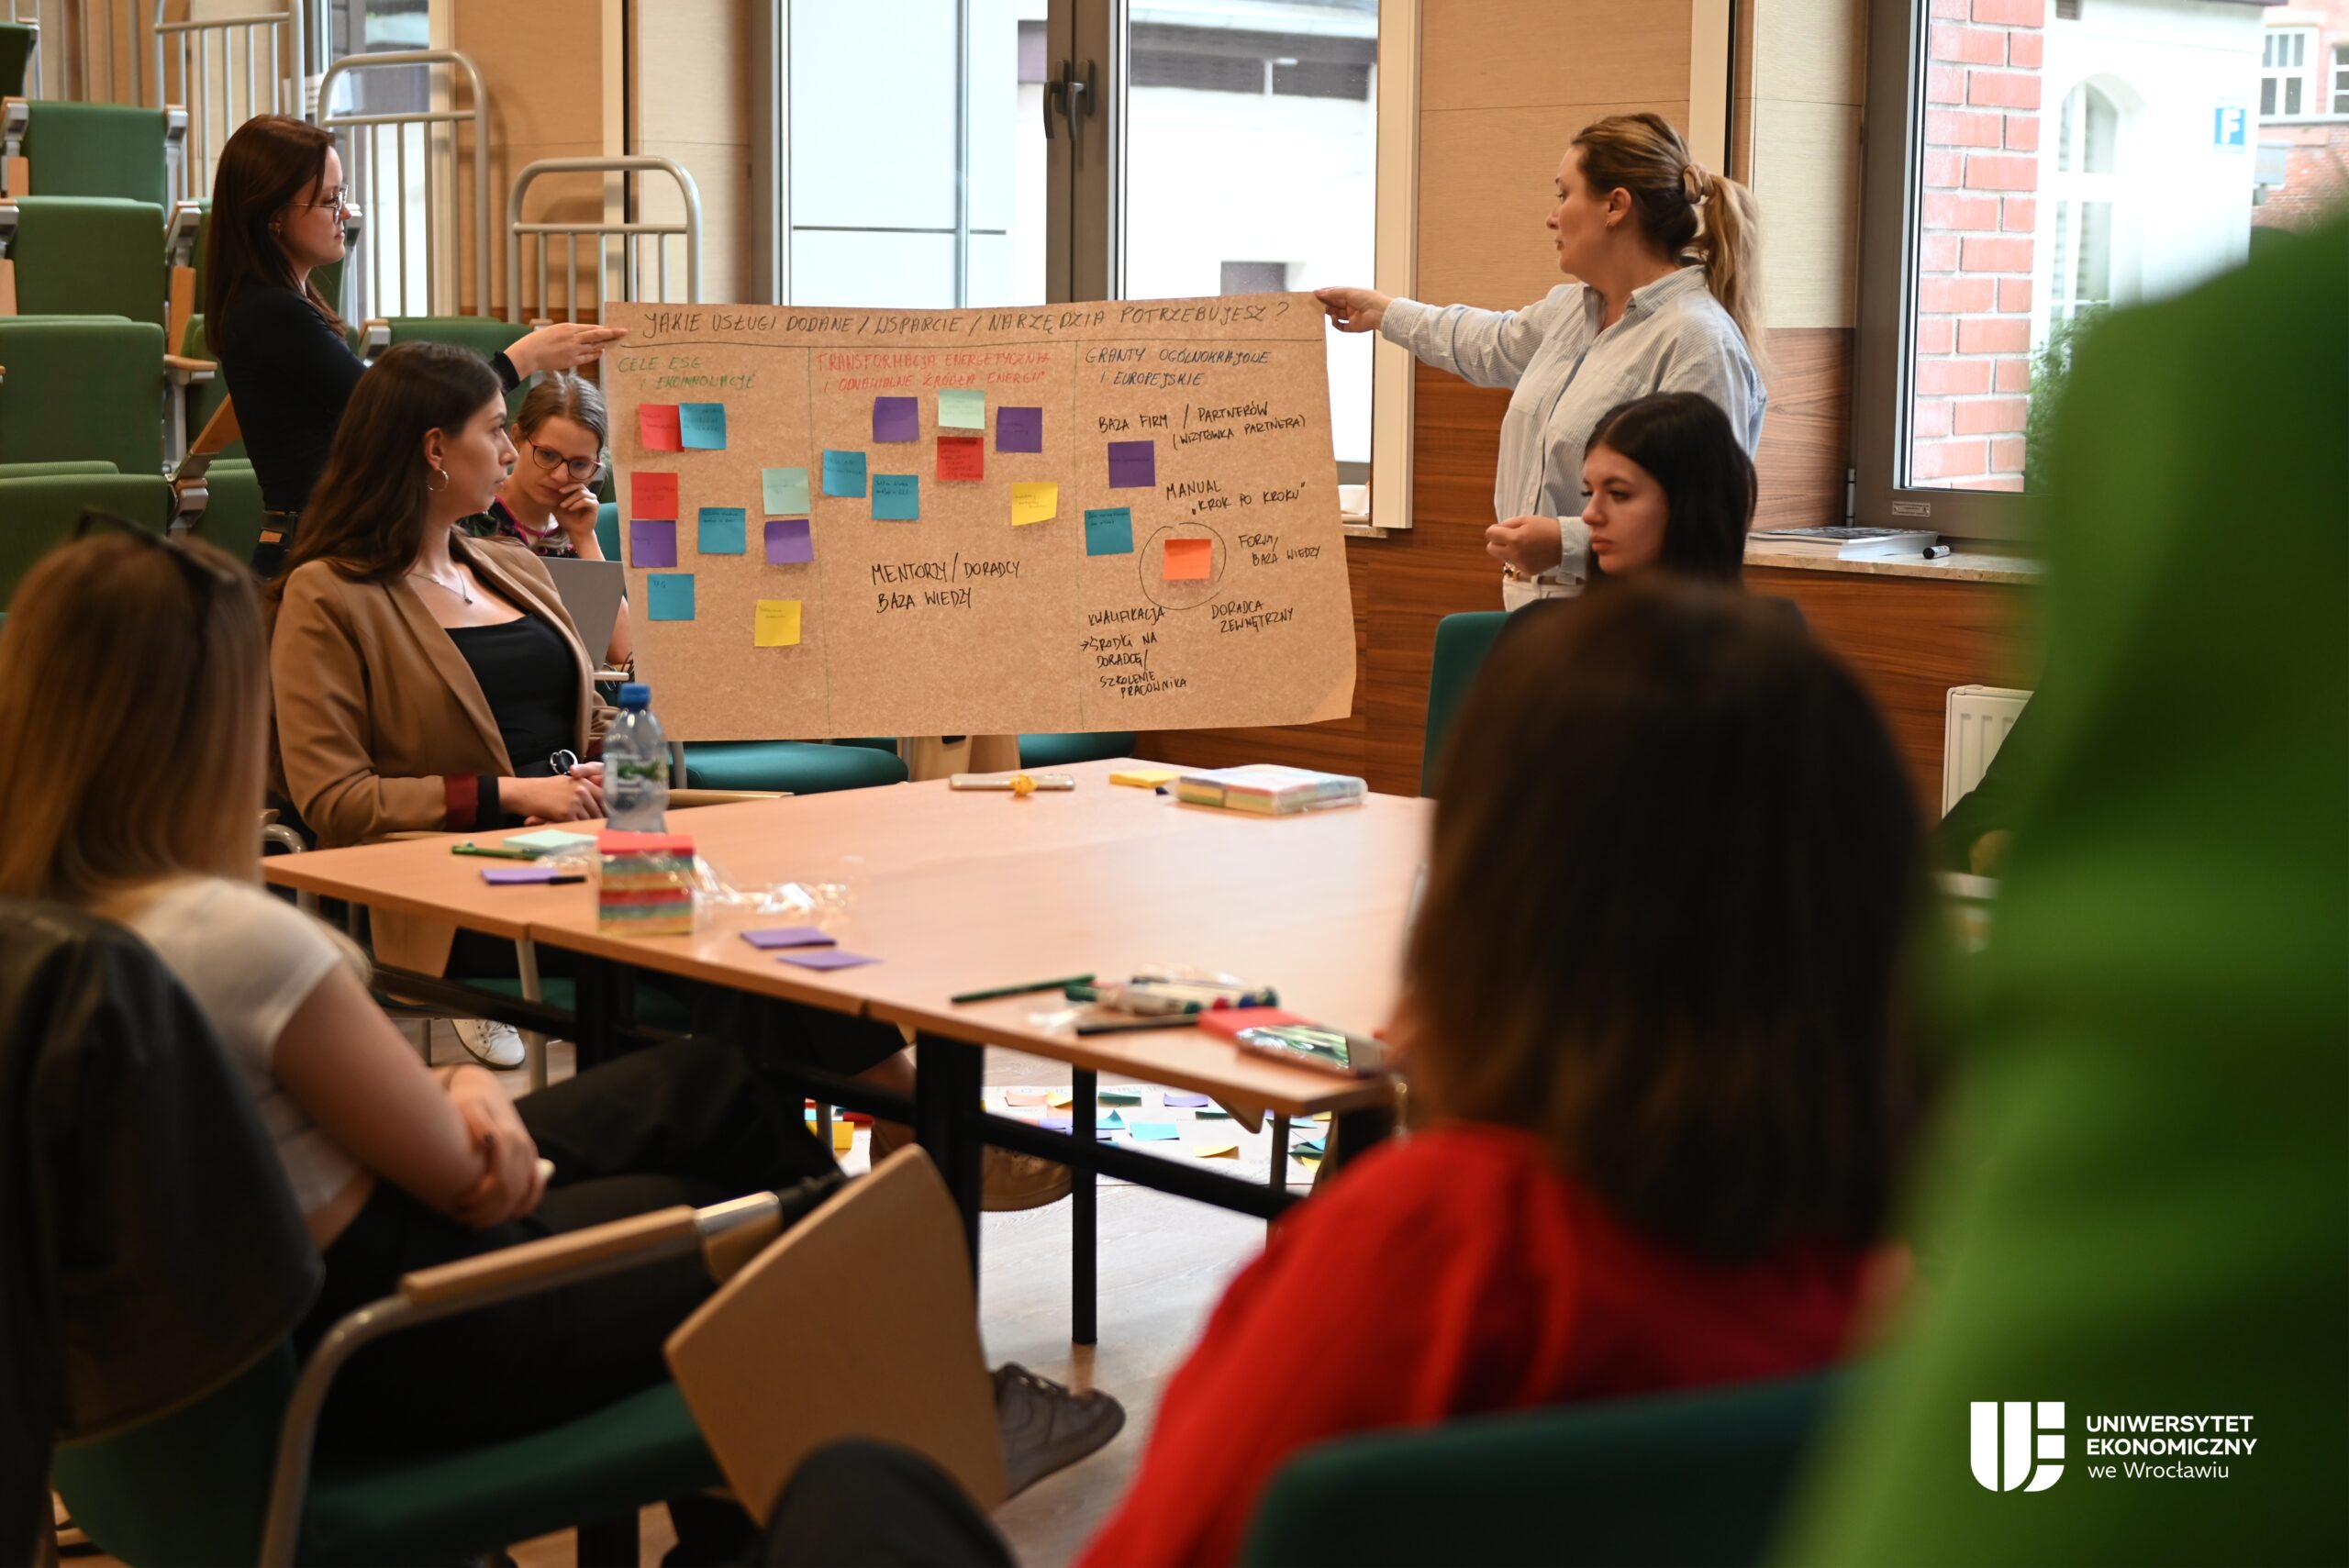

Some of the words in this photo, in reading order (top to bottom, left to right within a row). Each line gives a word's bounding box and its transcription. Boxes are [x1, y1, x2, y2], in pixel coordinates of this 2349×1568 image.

[2221, 108, 2241, 144] F
[643, 312, 702, 339] JAKIE
[712, 315, 776, 331] USŁUGI
[786, 315, 853, 332] DODANE
[874, 316, 963, 334] WSPARCIE
[988, 310, 1105, 334] NARZĘDZIA
[618, 356, 659, 373] CELE
[668, 356, 704, 370] ESG
[816, 352, 936, 371] TRANSFORMACJA
[945, 352, 1050, 368] ENERGETYCZNA
[1085, 347, 1146, 363] GRANTY
[1159, 348, 1272, 366] OGÓLNOKRAJOWE
[839, 374, 915, 391] ODNAWIALNE
[1113, 372, 1206, 389] EUROPEJSKIE
[1099, 416, 1130, 433] BAZA
[1140, 413, 1168, 429] FIRM
[1197, 401, 1268, 422] PARTNERÓW
[1166, 480, 1222, 501] MANUAL
[1240, 493, 1252, 506] PO
[1252, 552, 1279, 567] BAZA
[1286, 545, 1320, 561] WIEDZY
[964, 561, 1020, 579] DORADCY
[876, 592, 916, 613] BAZA
[924, 587, 972, 608] WIEDZY
[1211, 600, 1264, 619] DORADCA
[1088, 606, 1165, 626] KWALIFIKACJA
[1220, 607, 1294, 633] ZEWNĘTRZNY
[1142, 631, 1157, 645] NA
[1100, 671, 1156, 688] SZKOLENIE
